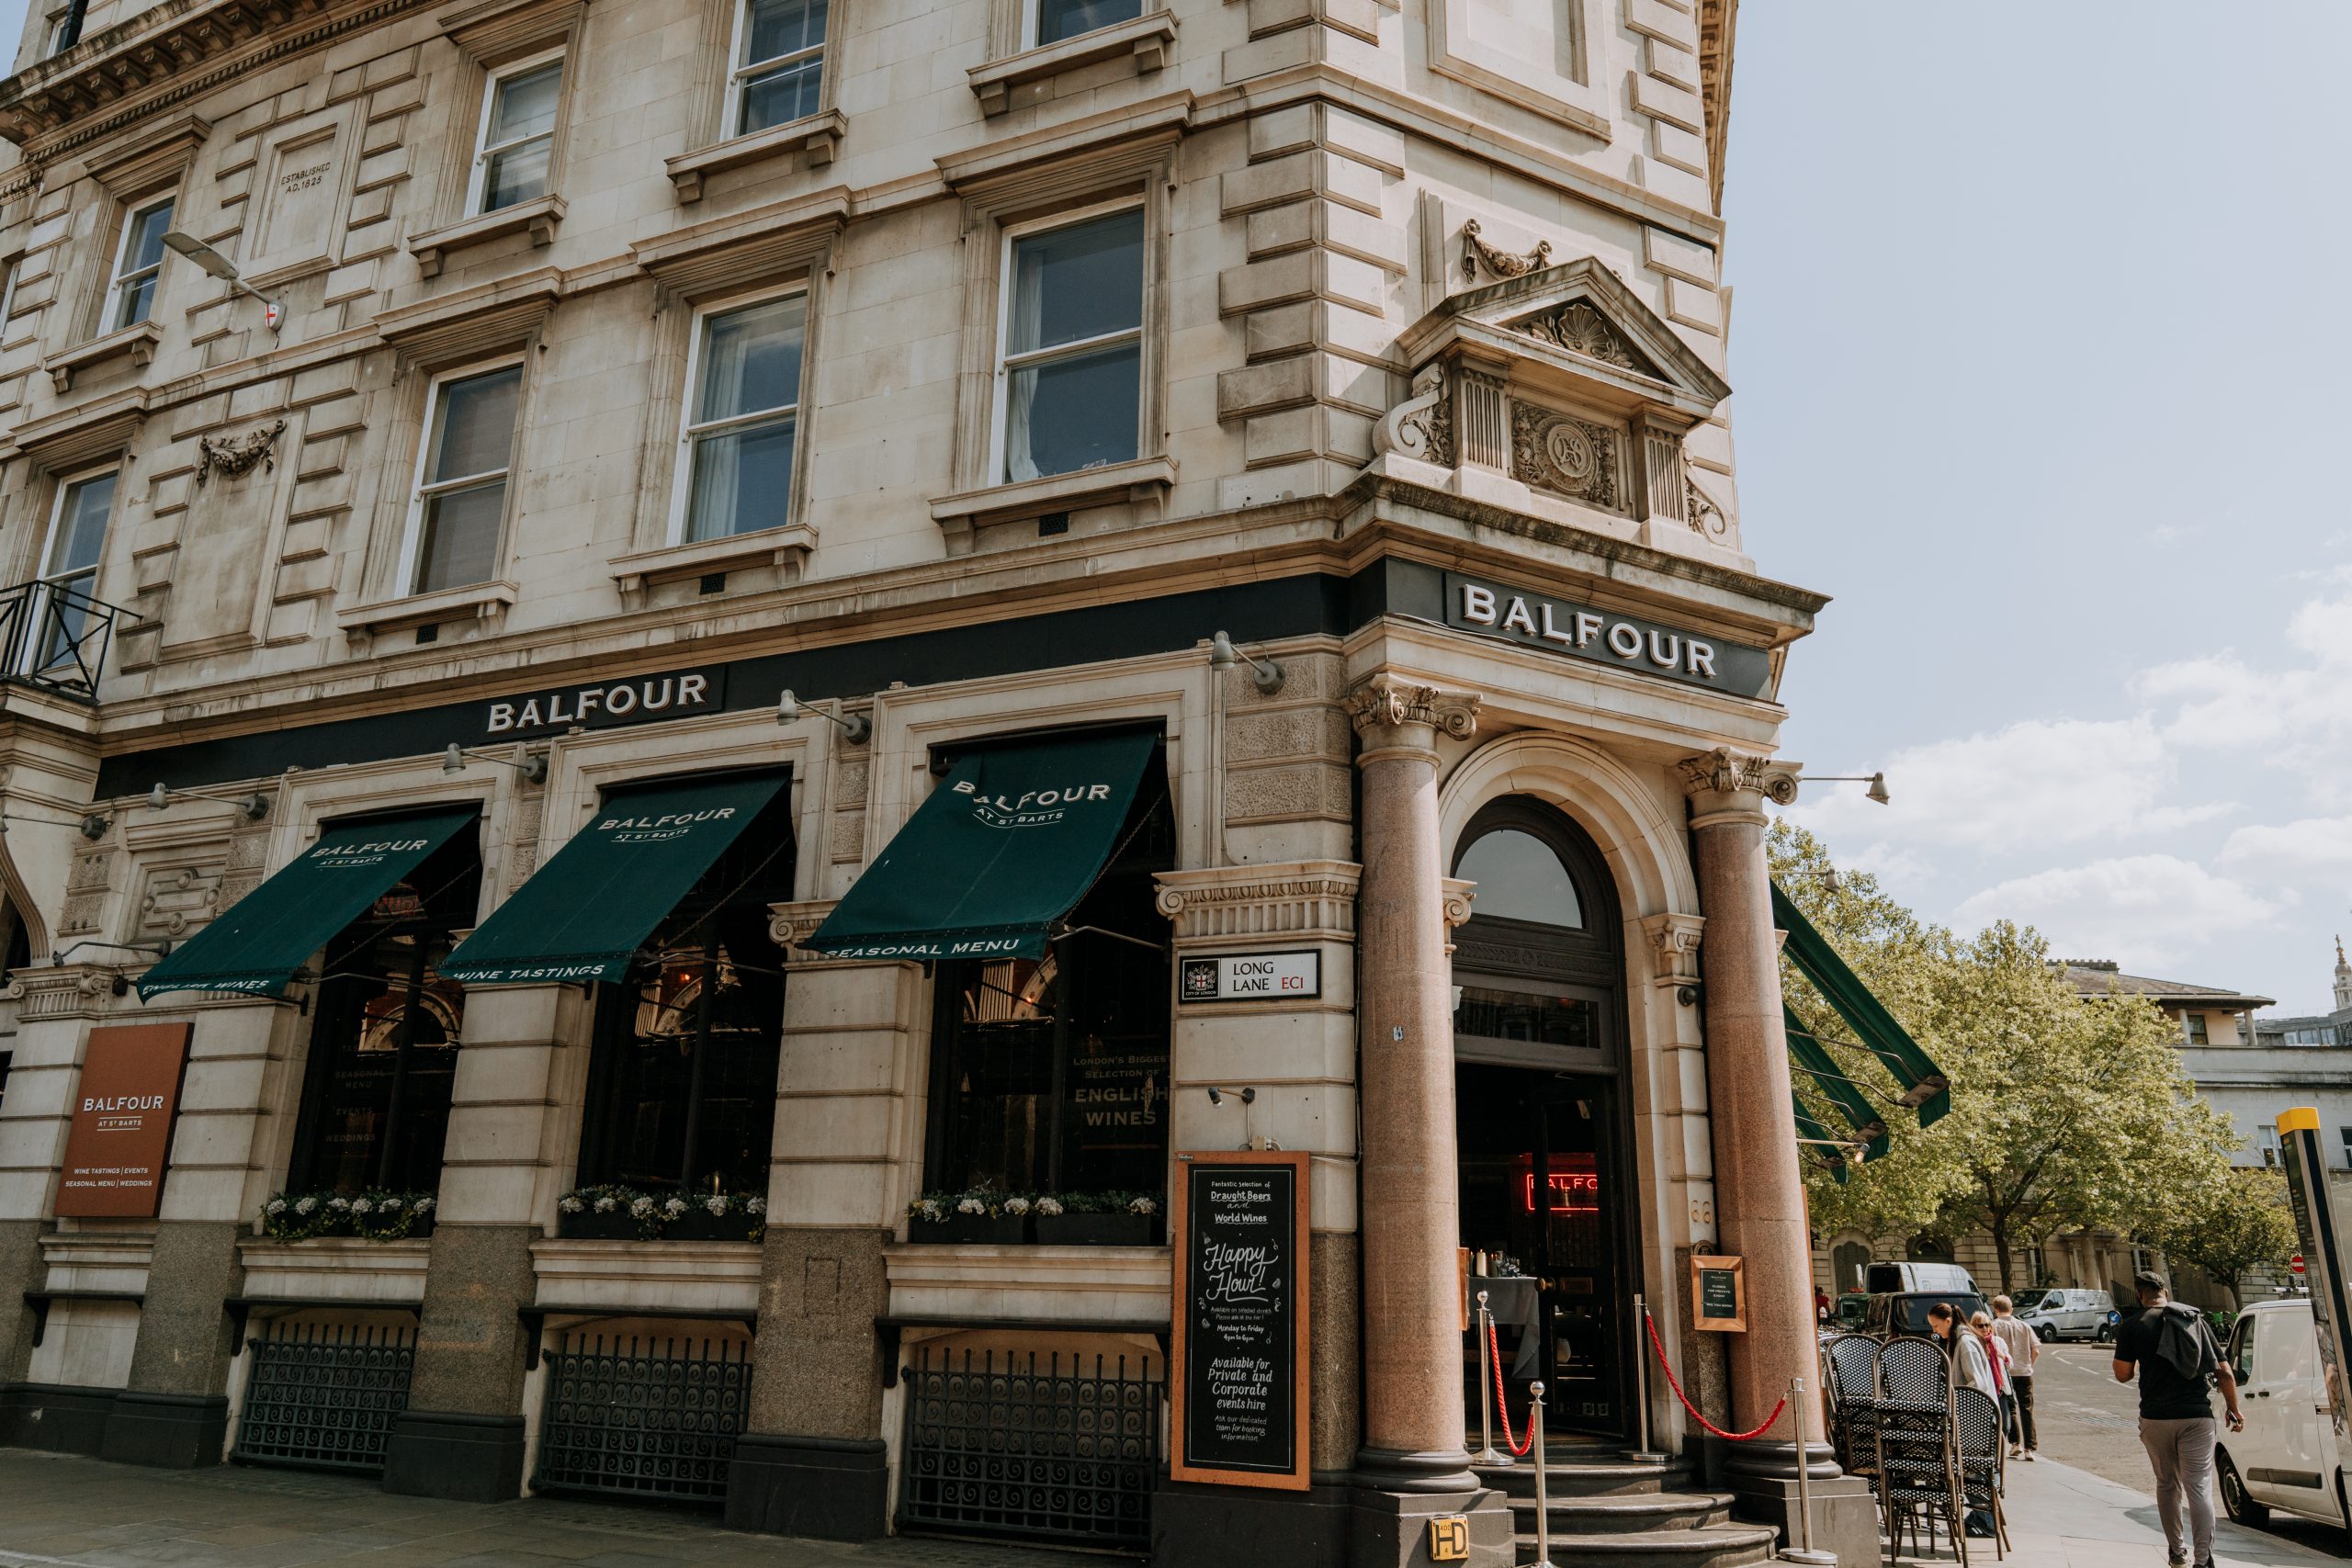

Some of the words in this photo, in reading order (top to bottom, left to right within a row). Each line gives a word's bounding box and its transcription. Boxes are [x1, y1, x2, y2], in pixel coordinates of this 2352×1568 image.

[281, 162, 331, 185] ESTABLISHED
[301, 175, 322, 189] 1825
[1464, 583, 1716, 679] BALFOUR
[487, 674, 709, 734] BALFOUR
[952, 781, 1112, 812] BALFOUR
[597, 807, 736, 830] BALFOUR
[977, 808, 994, 821] AT
[1017, 812, 1064, 823] BARTS
[651, 829, 689, 838] BARTS
[310, 840, 428, 858] BALFOUR
[826, 944, 943, 958] SEASONAL
[951, 939, 1020, 954] MENU
[453, 970, 503, 980] WINE
[509, 964, 605, 979] TASTINGS
[1233, 962, 1274, 976] LONG
[214, 980, 270, 989] WINES
[1233, 978, 1270, 992] LANE
[1073, 1056, 1125, 1066] LONDON'S
[1085, 1069, 1143, 1078] SELECTION
[84, 1096, 164, 1111] BALFOUR
[1086, 1111, 1157, 1126] WINES
[324, 1134, 376, 1143] WEDDINGS
[1211, 1190, 1247, 1201] Draught
[1248, 1190, 1272, 1201] Beers
[1215, 1213, 1240, 1223] World
[1242, 1213, 1267, 1223] Wines
[1690, 1200, 1712, 1224] 66
[1204, 1243, 1278, 1277] Happy
[1206, 1266, 1269, 1303] Hour!
[1216, 1325, 1239, 1333] Monday
[1247, 1325, 1264, 1334] Friday
[1223, 1333, 1236, 1342] 4pm
[1241, 1334, 1255, 1343] 6pm
[1212, 1357, 1254, 1369] Available
[1255, 1358, 1271, 1372] for
[1207, 1368, 1247, 1381] Private
[1252, 1370, 1273, 1382] and
[1212, 1382, 1268, 1399] Corporate
[1216, 1398, 1246, 1409] events
[1246, 1398, 1266, 1411] hire
[1238, 1415, 1267, 1425] dedicated
[1221, 1433, 1259, 1442] information
[1231, 1424, 1240, 1433] for
[1241, 1424, 1266, 1437] booking
[1436, 1522, 1466, 1556] HD
